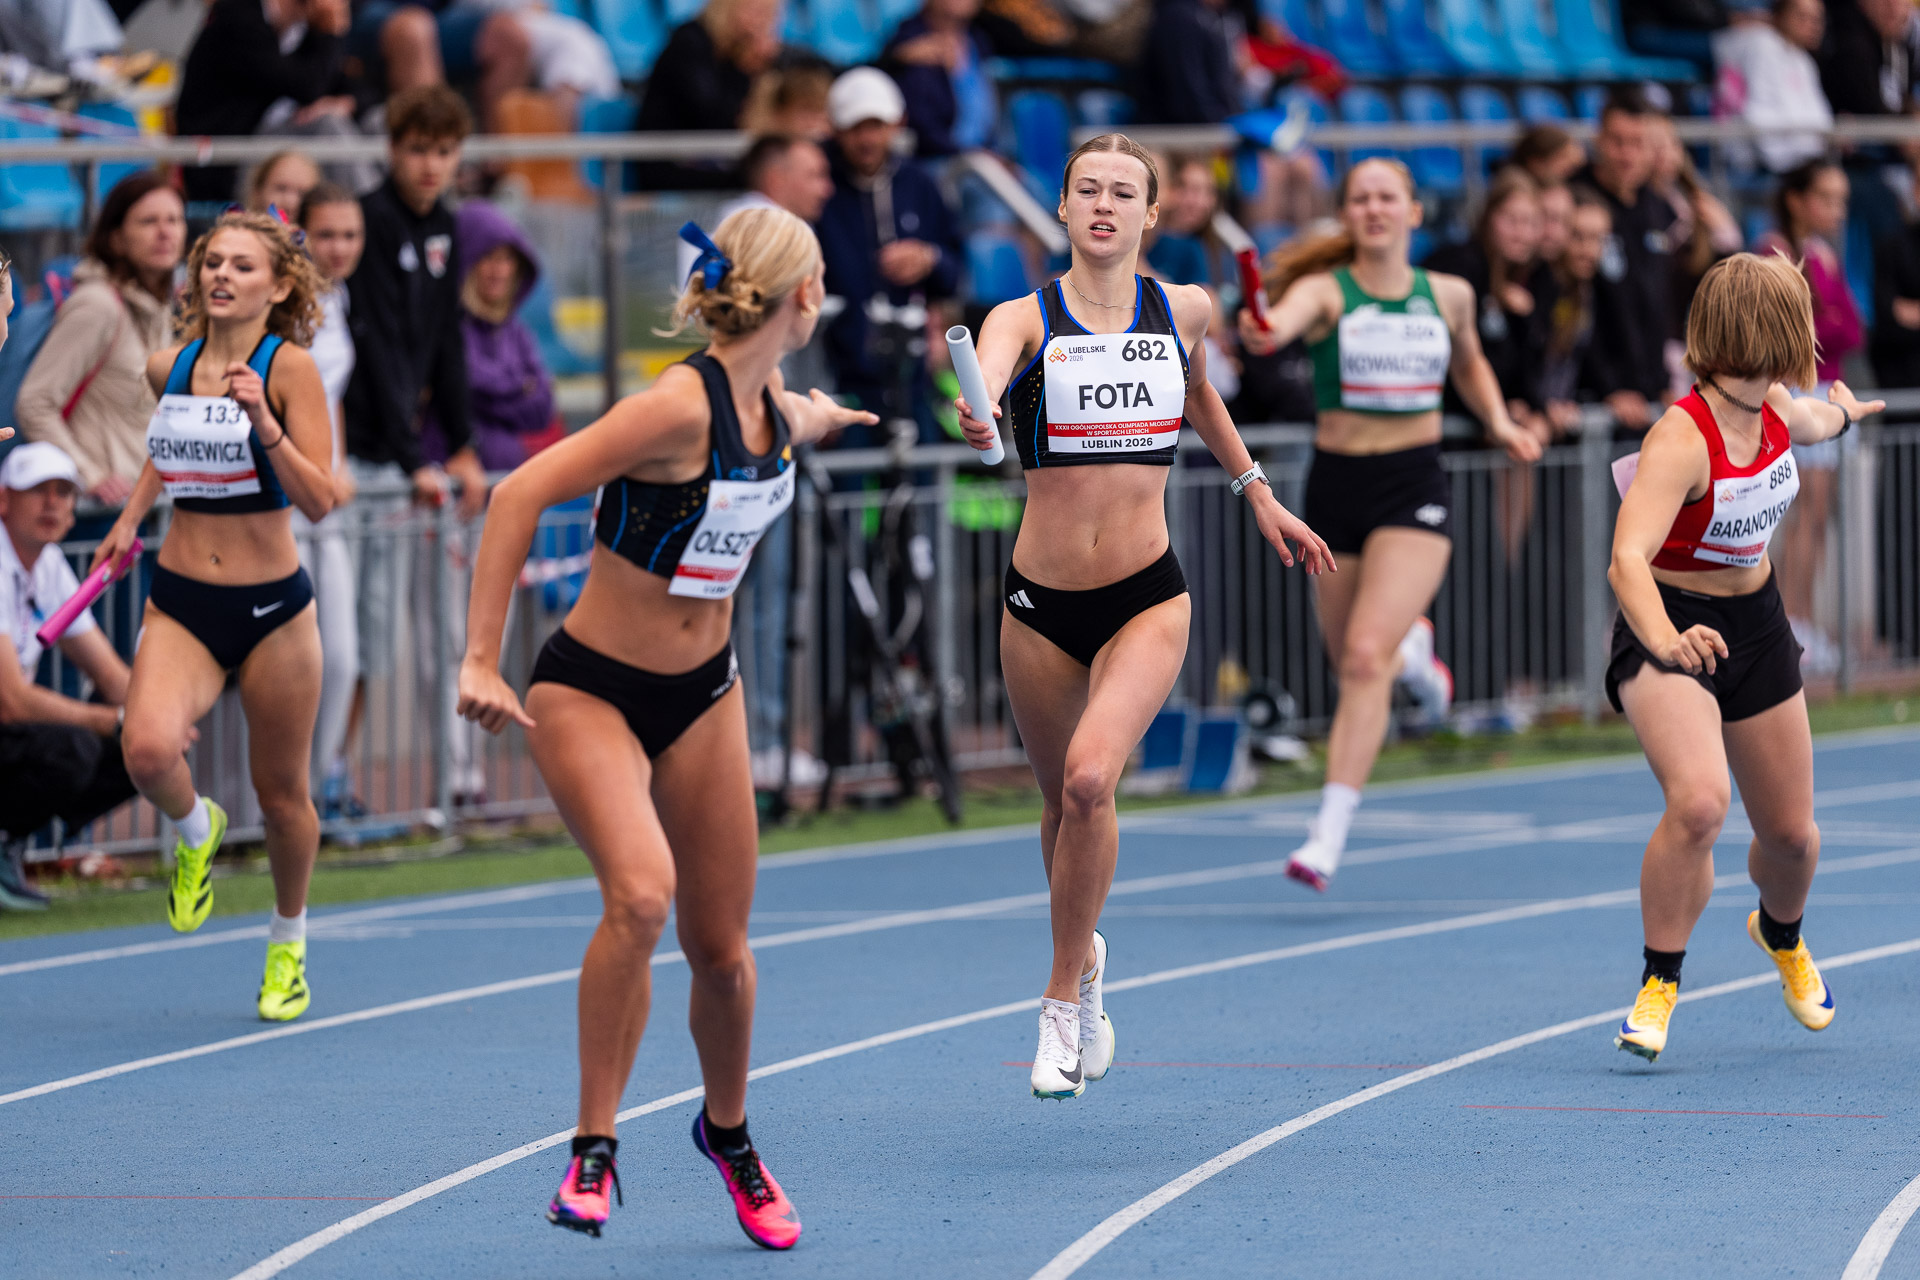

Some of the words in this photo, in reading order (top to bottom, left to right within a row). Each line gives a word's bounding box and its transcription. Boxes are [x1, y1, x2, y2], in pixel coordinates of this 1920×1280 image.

[1068, 345, 1107, 354] LUBELSKIE
[1069, 354, 1084, 362] 2026
[1121, 339, 1169, 362] 682
[1078, 381, 1154, 411] FOTA
[203, 404, 242, 425] 133
[1070, 423, 1117, 431] OGÓLNOPOLSKA
[1117, 421, 1149, 430] OLIMPIADA
[148, 436, 247, 463] SIENKIEWICZ
[1081, 439, 1123, 449] LUBLIN
[1125, 437, 1153, 448] 2026
[1769, 459, 1792, 490] 888
